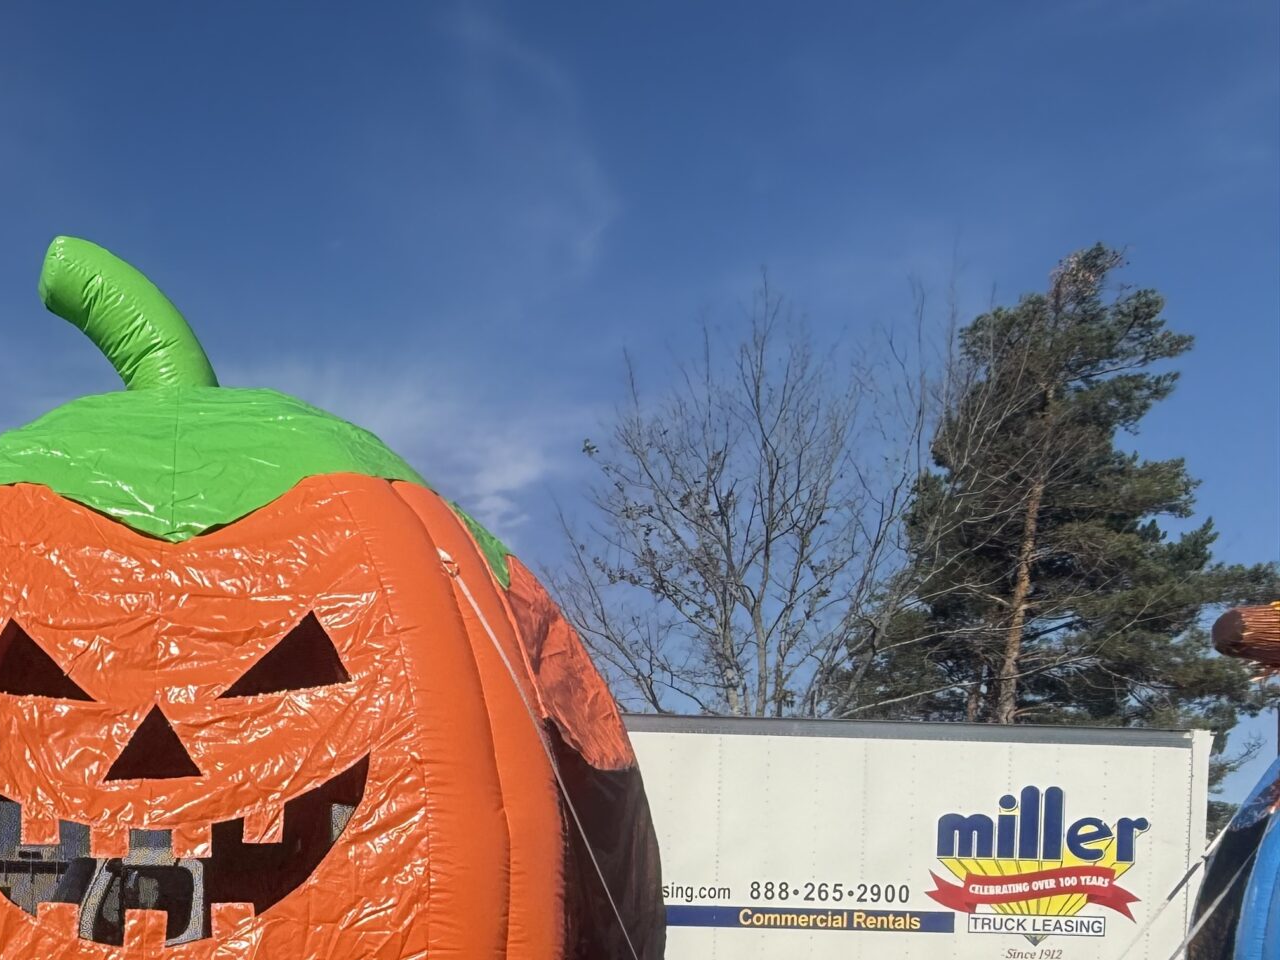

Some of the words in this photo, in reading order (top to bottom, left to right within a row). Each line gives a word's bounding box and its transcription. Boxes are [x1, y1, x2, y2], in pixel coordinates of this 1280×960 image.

[937, 785, 1150, 862] miller
[969, 883, 1030, 895] CELEBRATING
[1031, 880, 1057, 891] OVER
[1059, 877, 1078, 887] 100
[1080, 875, 1109, 888] YEARS
[738, 908, 847, 929] Commercial
[852, 911, 921, 930] Rentals
[970, 917, 1027, 933] TRUCK
[1031, 917, 1104, 934] LEASING
[1005, 948, 1037, 960] Since
[1038, 949, 1063, 960] 1912
